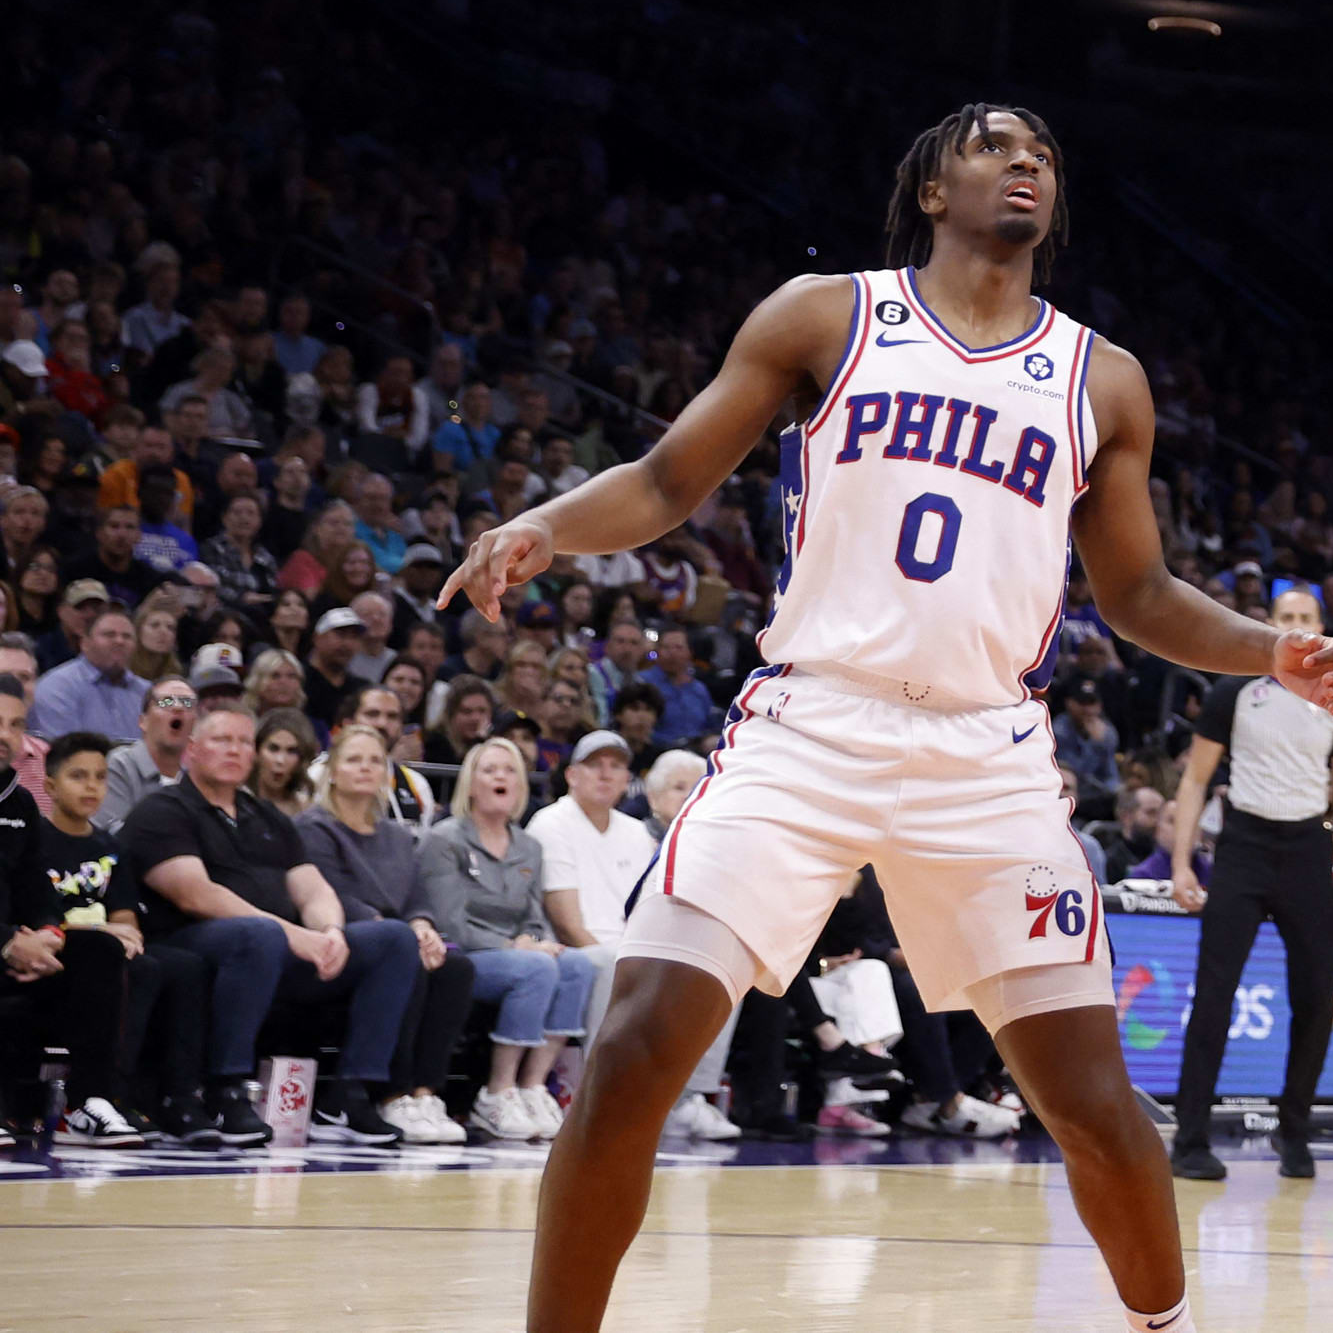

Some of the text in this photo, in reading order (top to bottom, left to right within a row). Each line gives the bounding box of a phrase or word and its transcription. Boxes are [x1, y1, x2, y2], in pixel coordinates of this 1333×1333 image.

[882, 303, 905, 323] 6
[1007, 379, 1064, 401] crypto.com
[836, 390, 1057, 508] PHILA
[895, 492, 963, 583] 0
[1025, 889, 1086, 940] 76
